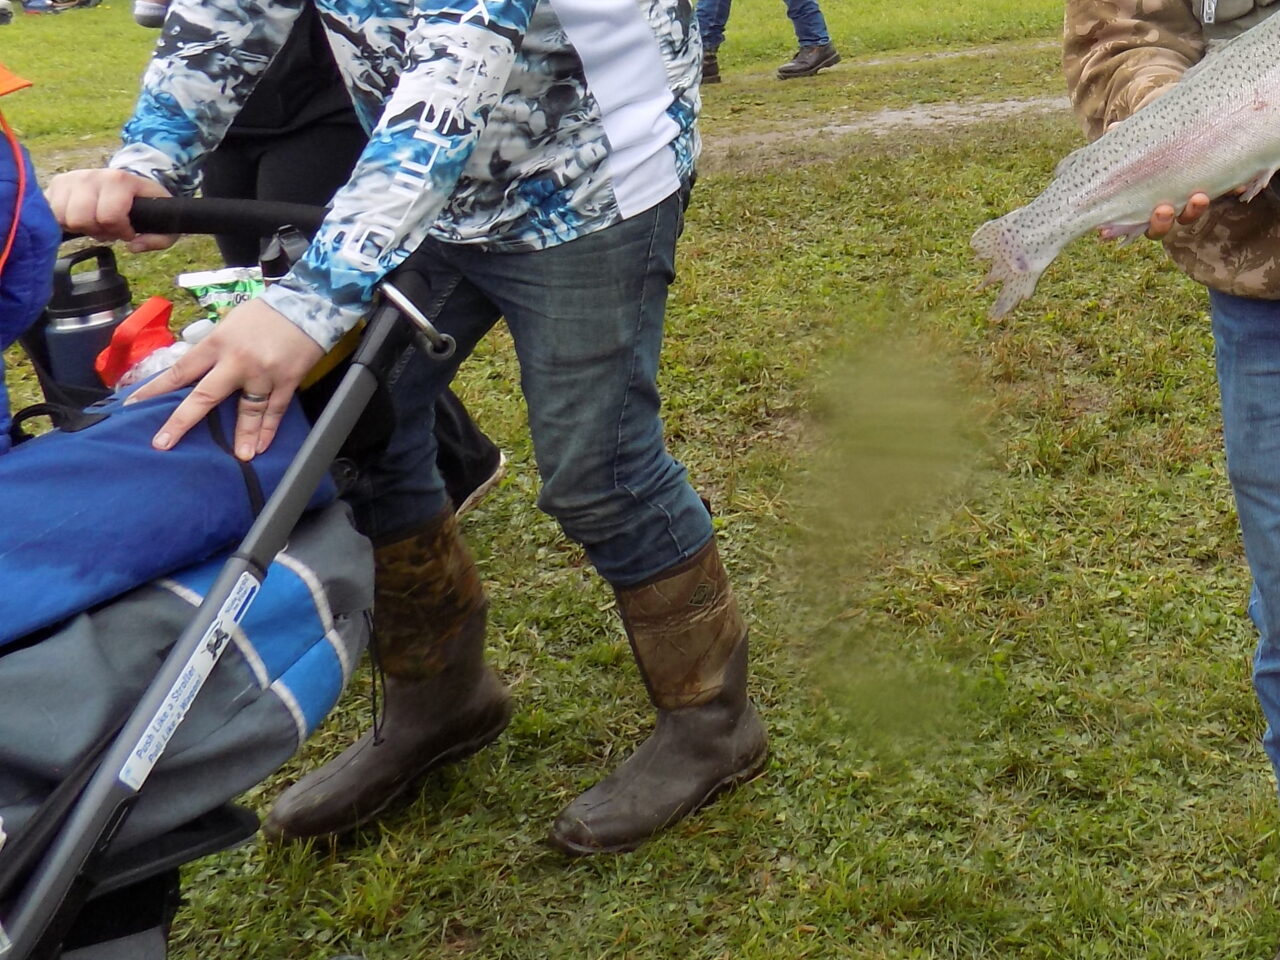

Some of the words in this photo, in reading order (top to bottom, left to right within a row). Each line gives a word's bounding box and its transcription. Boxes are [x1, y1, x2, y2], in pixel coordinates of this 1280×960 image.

[136, 732, 155, 760] Push
[154, 711, 170, 732] Like
[171, 665, 197, 703] Stroller
[147, 741, 164, 763] Pull
[162, 720, 177, 741] Like
